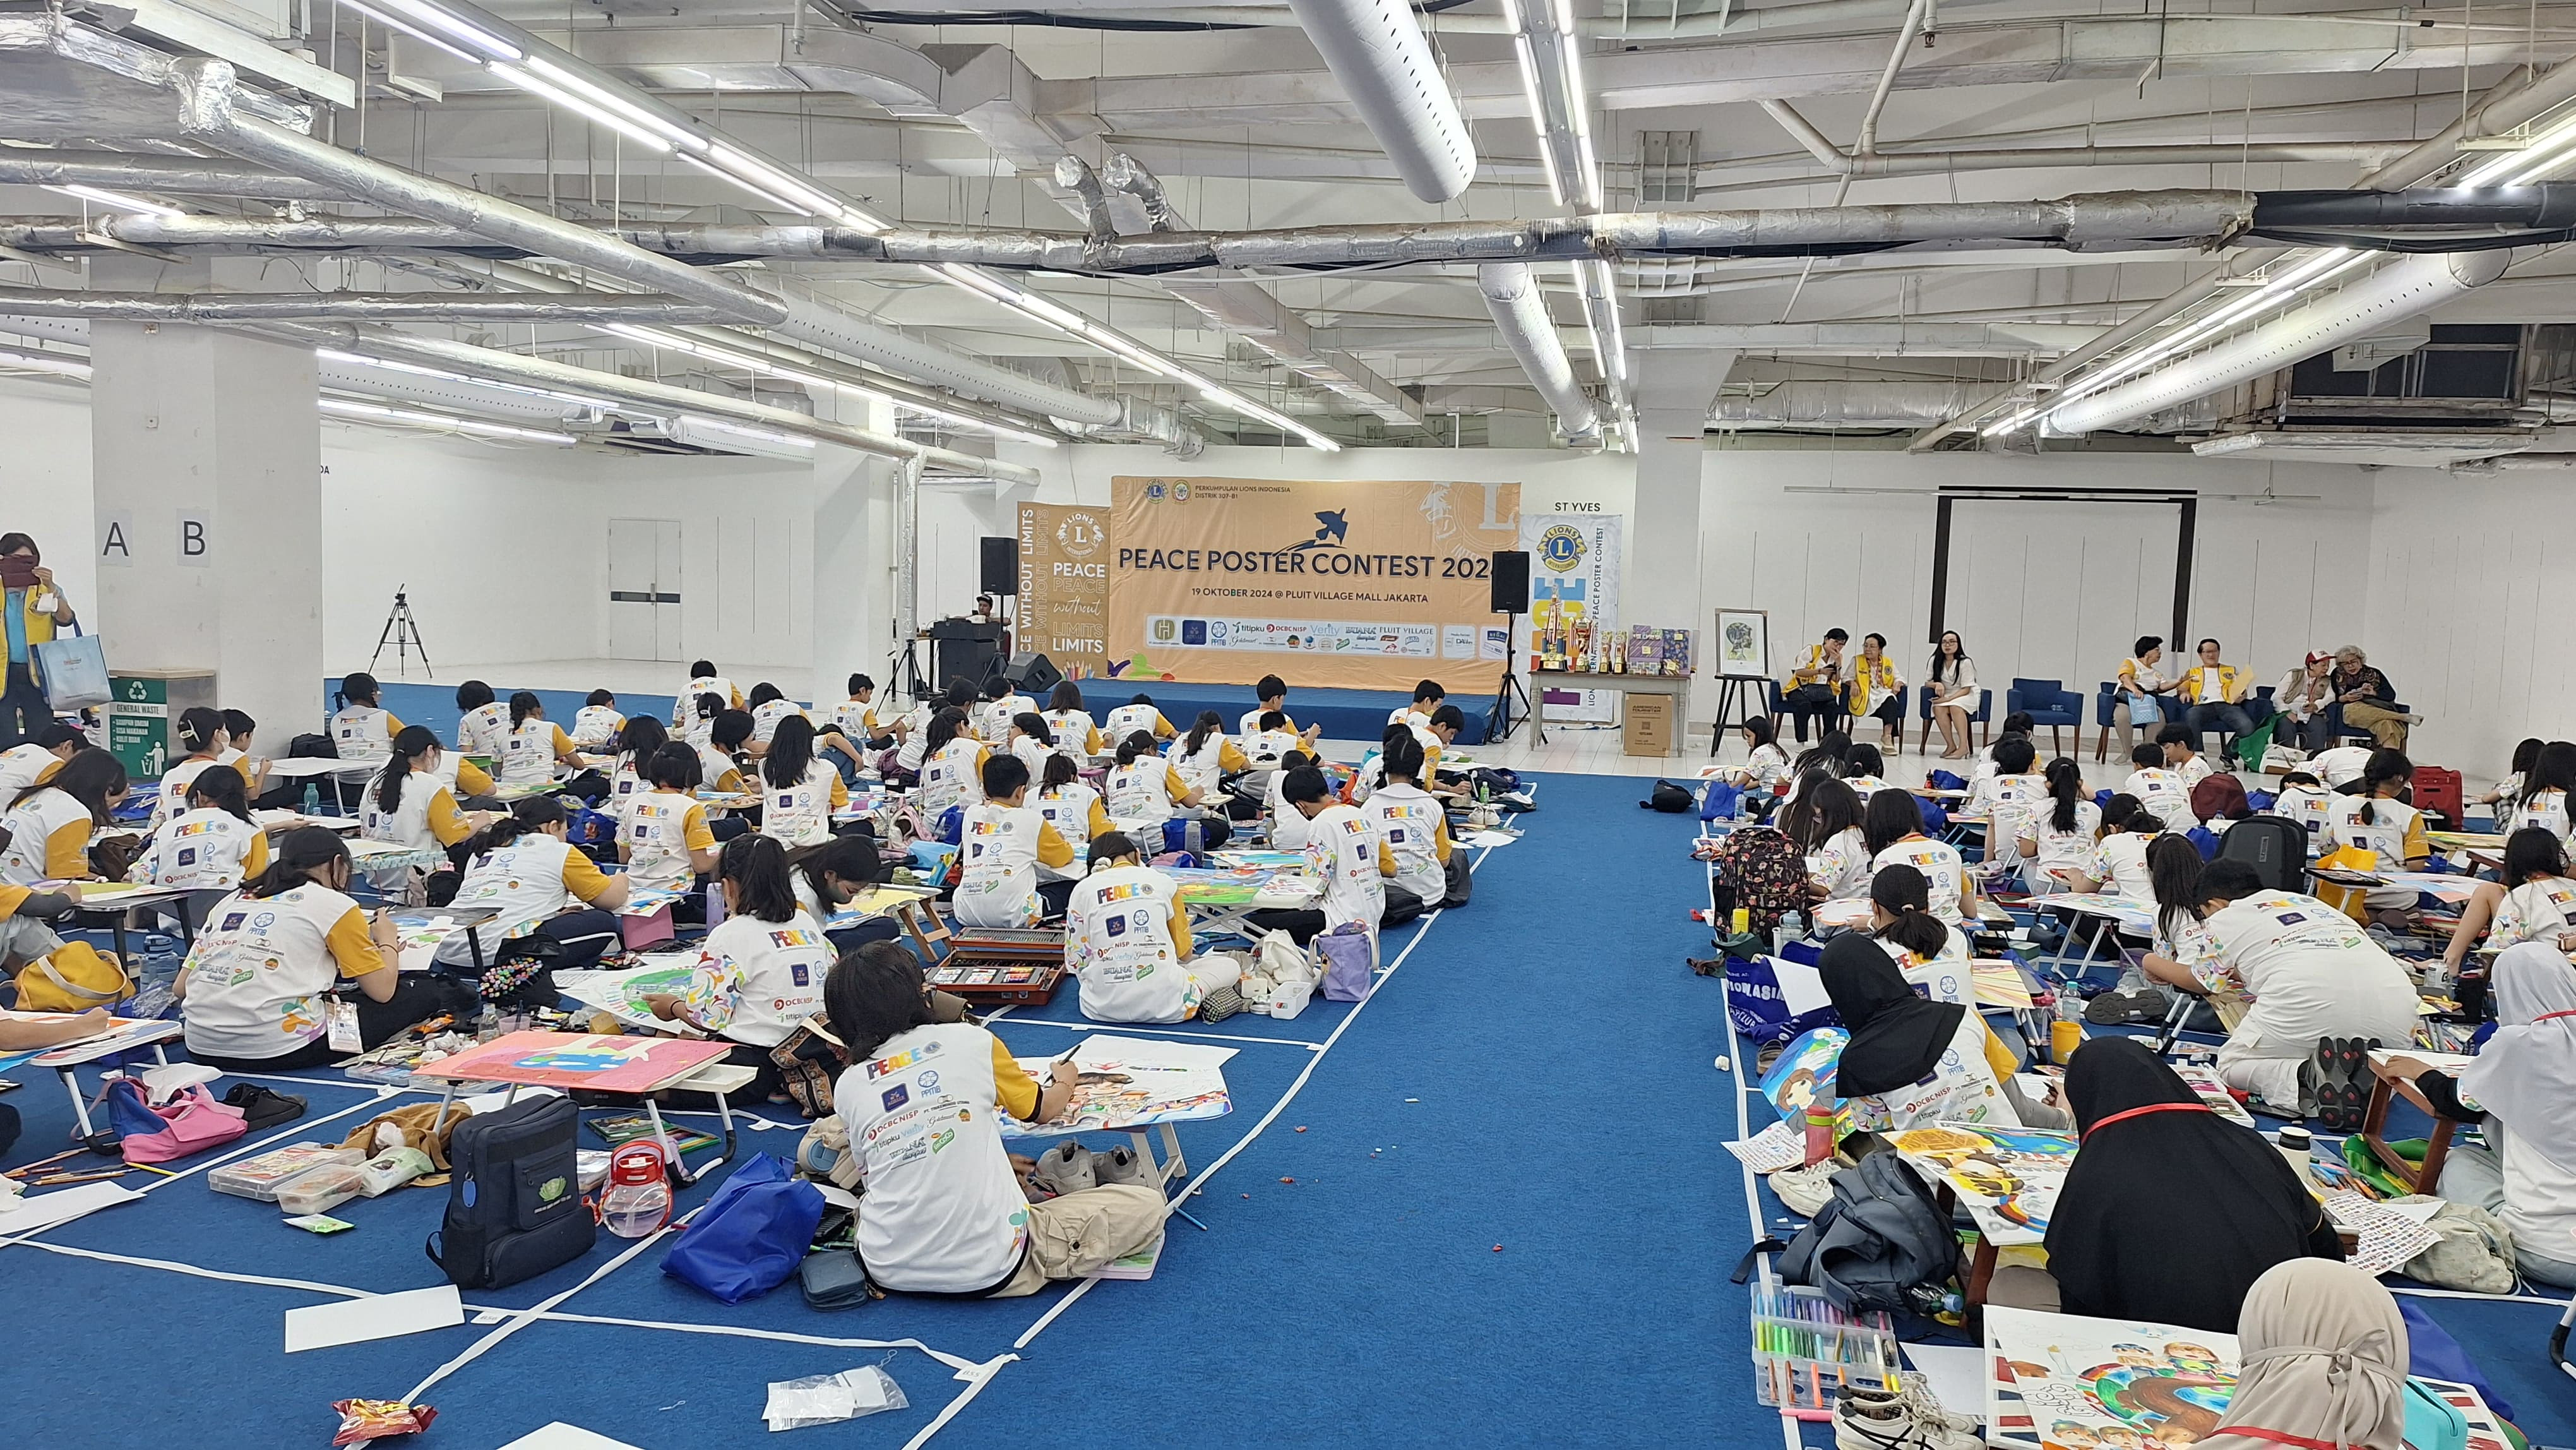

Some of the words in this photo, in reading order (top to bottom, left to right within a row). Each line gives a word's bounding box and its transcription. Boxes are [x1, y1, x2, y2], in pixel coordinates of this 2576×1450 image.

[1555, 502, 1569, 512] ST
[1571, 503, 1601, 512] YVES
[1067, 513, 1094, 525] LIONS
[103, 522, 129, 556] A
[183, 520, 206, 556] B
[1022, 509, 1034, 555] LIMITS
[1037, 509, 1049, 556] LIMITS
[1075, 526, 1087, 543] L
[1549, 527, 1577, 537] LIONS
[1556, 539, 1570, 556] L
[1595, 527, 1604, 562] CONTEST
[1053, 563, 1105, 578] PEACE
[1119, 548, 1200, 571] PEACE
[1208, 550, 1306, 573] POSTER
[1311, 553, 1435, 577] CONTEST
[1441, 557, 1489, 580] 202
[1053, 578, 1105, 594] PEACE
[1594, 564, 1602, 592] POSTER
[1021, 561, 1033, 629] WITHOUT
[1035, 561, 1048, 630] WITHOUT
[1192, 588, 1201, 596] 19
[1204, 588, 1248, 597] OKTOBER
[1250, 590, 1273, 598] 2024
[1275, 590, 1284, 599] @
[1286, 590, 1312, 599] PLUIT
[1314, 591, 1354, 601] VILLAGE
[1356, 593, 1381, 601] MALL
[1384, 594, 1429, 602] JAKARTA
[1053, 596, 1101, 618] without
[1053, 621, 1104, 638] LIMITS
[1241, 623, 1265, 635] titipku
[1052, 638, 1104, 653] LIMITS
[117, 704, 140, 714] GENERAL
[141, 706, 159, 714] WASTE
[1383, 805, 1415, 819] PEACE
[174, 820, 215, 838] PEACE
[1909, 852, 1938, 865] PEACE
[1097, 883, 1140, 905] PEACE
[247, 927, 268, 937] PPMB
[768, 930, 813, 949] PEACE
[785, 998, 804, 1007] OCBC
[866, 1046, 923, 1081] PEACE
[1947, 1064, 1965, 1076] PPMB
[921, 1085, 941, 1099] PPMB
[1916, 1093, 1935, 1108] OCBC
[1934, 1086, 1951, 1099] NISP
[877, 1118, 898, 1133] OCBC
[899, 1110, 919, 1122] NISP
[879, 1134, 900, 1148] titipku
